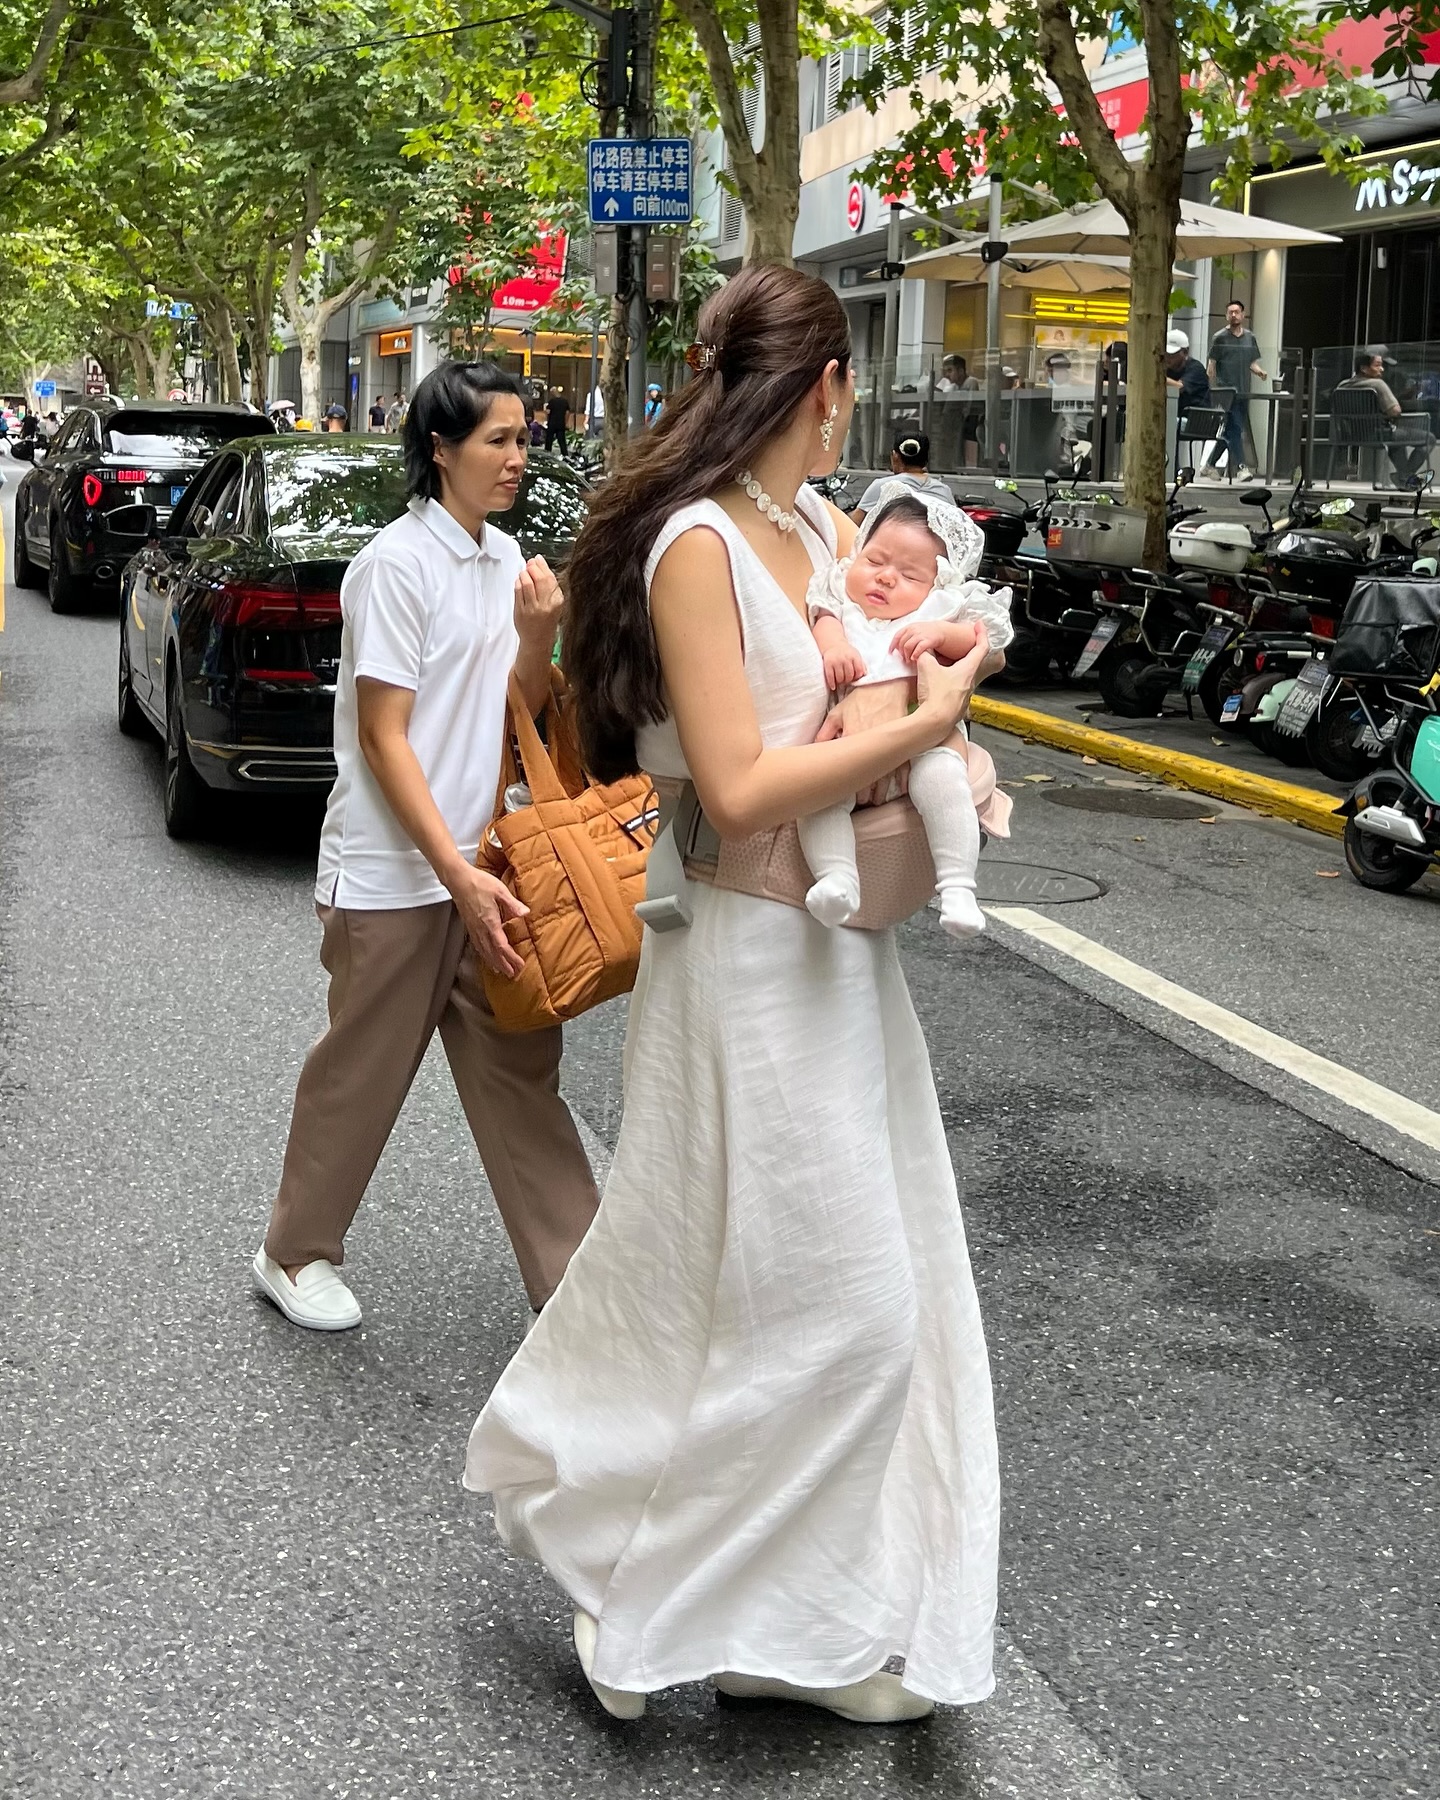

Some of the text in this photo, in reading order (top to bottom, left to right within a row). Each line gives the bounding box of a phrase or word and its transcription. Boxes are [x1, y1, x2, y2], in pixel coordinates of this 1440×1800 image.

[592, 146, 689, 169] 此路段禁止停车
[593, 170, 688, 193] 停车请至停车库
[502, 296, 525, 307] 10m
